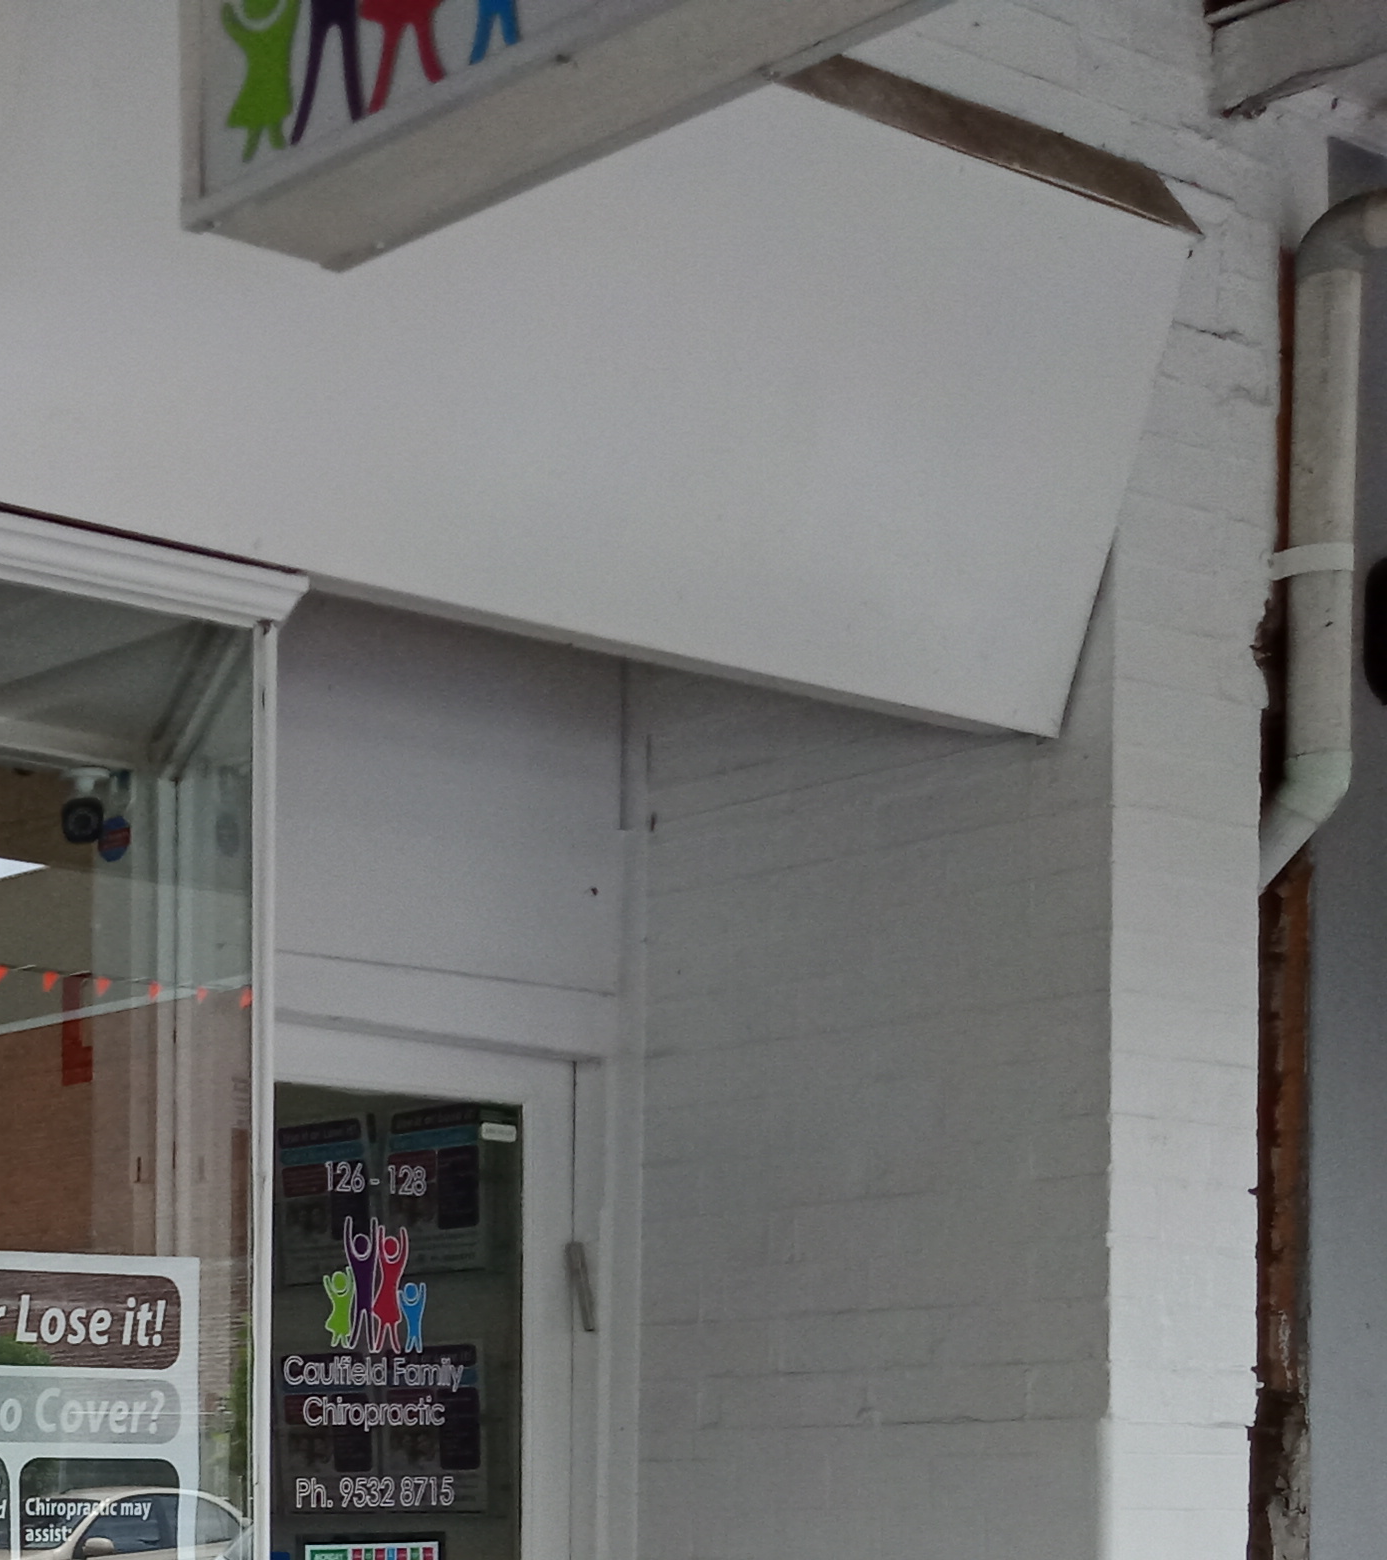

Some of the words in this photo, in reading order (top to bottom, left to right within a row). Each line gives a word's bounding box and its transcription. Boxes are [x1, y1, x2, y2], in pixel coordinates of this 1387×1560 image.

[325, 1161, 365, 1192] 126
[387, 1165, 427, 1196] 128
[17, 1294, 110, 1344] Lose
[122, 1297, 167, 1346] it!
[284, 1355, 387, 1386] Caulfield
[393, 1358, 463, 1392] Family
[303, 1396, 445, 1431] Chiropractic
[296, 1478, 332, 1508] Ph.
[340, 1477, 395, 1506] 9532
[400, 1476, 455, 1505] 8715
